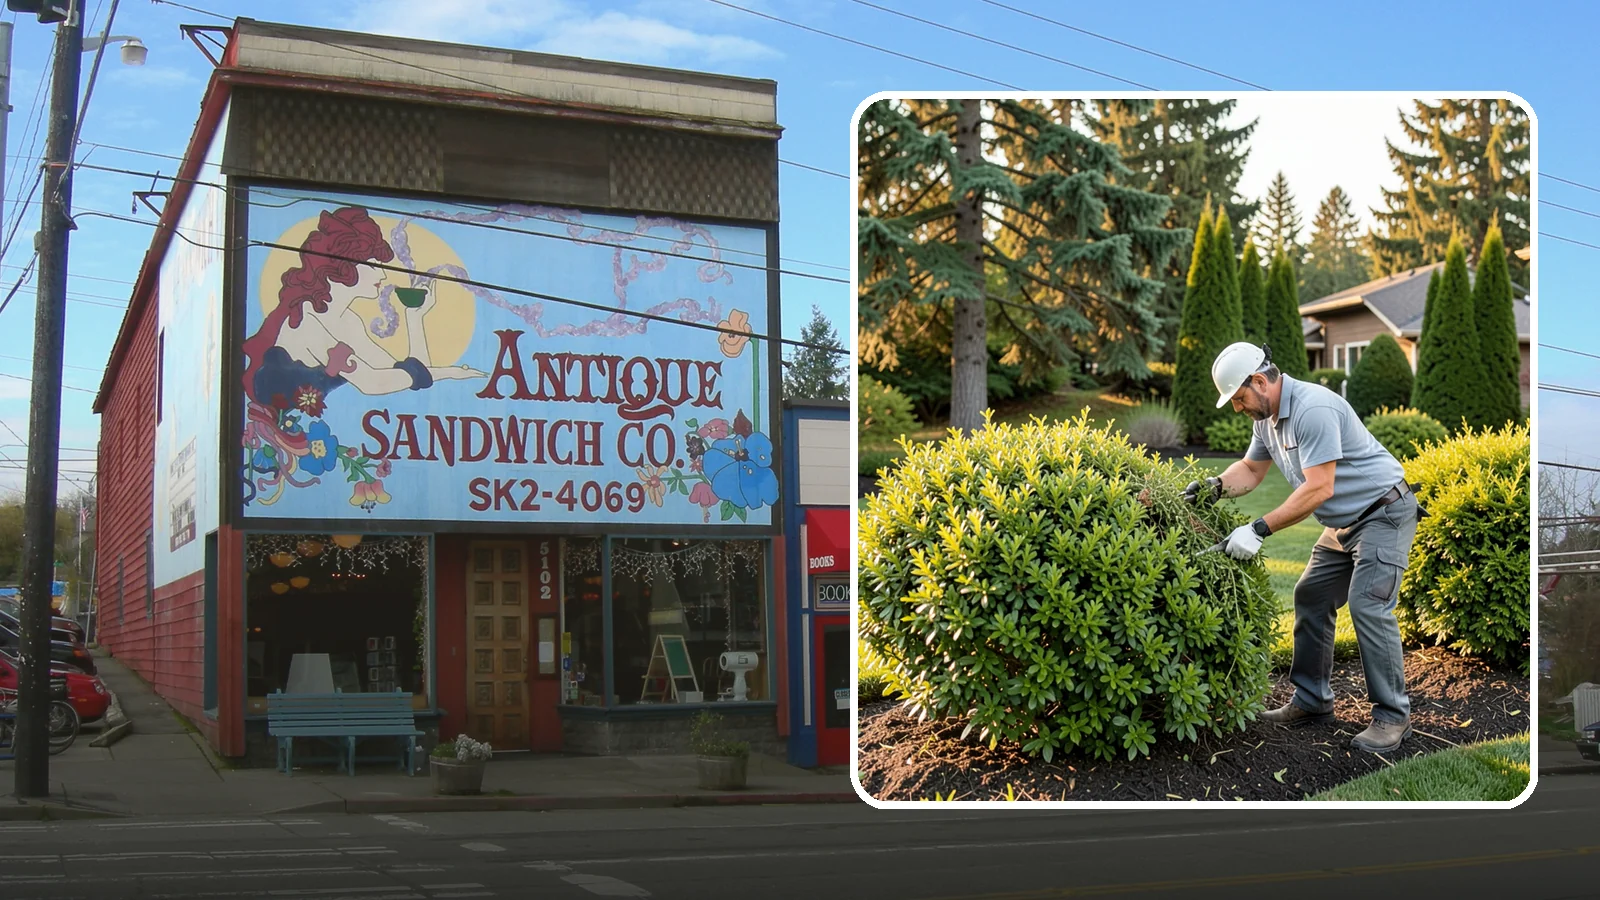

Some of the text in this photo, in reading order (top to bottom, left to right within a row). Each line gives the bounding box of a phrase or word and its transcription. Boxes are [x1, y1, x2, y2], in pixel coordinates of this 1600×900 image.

[475, 328, 723, 421] ANTIQUE
[361, 408, 686, 469] SANDWICH CO.
[468, 477, 646, 513] SK2-4069
[539, 541, 552, 600] 5102
[809, 555, 835, 569] BOOKS
